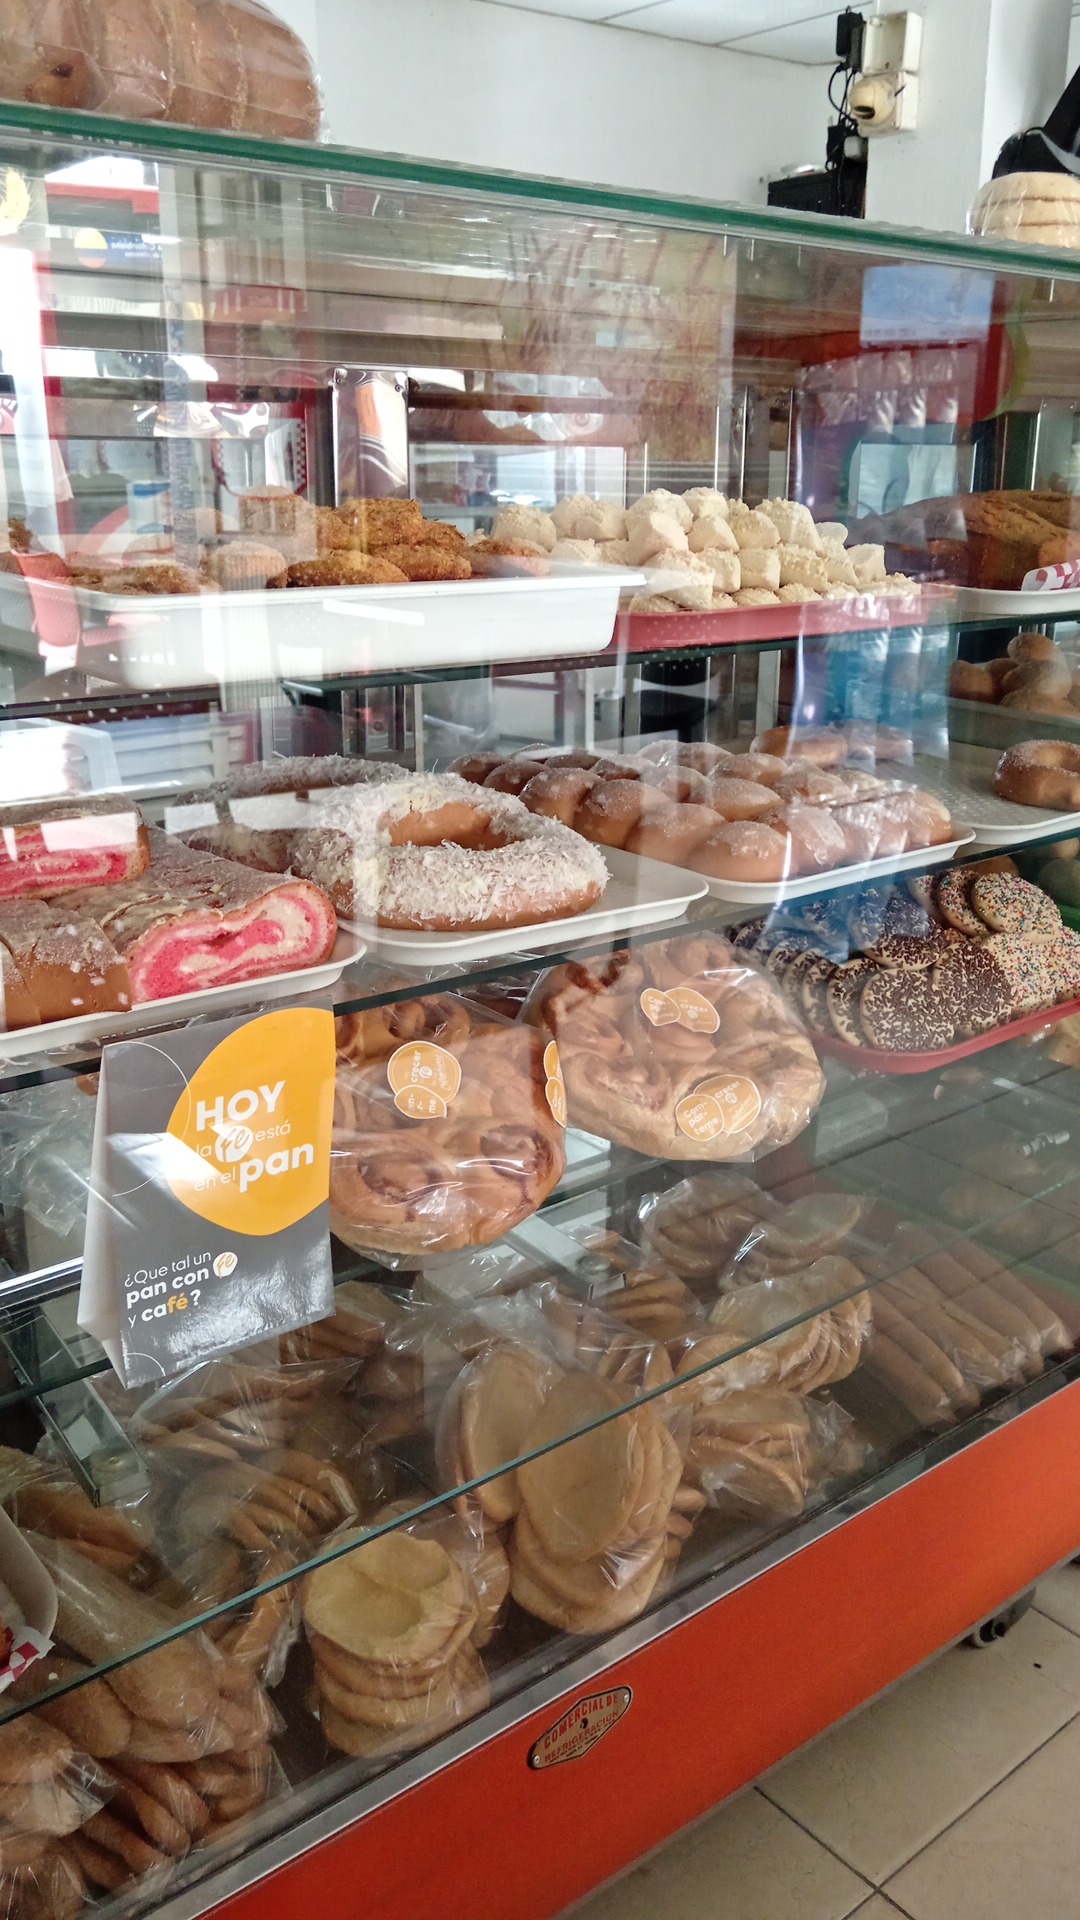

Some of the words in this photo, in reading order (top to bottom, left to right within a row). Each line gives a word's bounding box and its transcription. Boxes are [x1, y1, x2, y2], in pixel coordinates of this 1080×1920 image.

[411, 1049, 421, 1083] crecer
[196, 1080, 287, 1132] HOY
[714, 1080, 741, 1099] crecer
[683, 1101, 708, 1118] Com-
[688, 1111, 708, 1129] par-
[693, 1117, 719, 1136] teme
[196, 1143, 212, 1158] la
[255, 1119, 291, 1142] está
[194, 1175, 216, 1192] en
[220, 1166, 236, 1184] el
[239, 1143, 314, 1193] pan
[124, 1265, 168, 1288] ¿Que
[171, 1254, 190, 1273] tal
[193, 1251, 212, 1266] un
[126, 1281, 167, 1309] pan
[171, 1267, 209, 1289] con
[127, 1314, 137, 1329] y
[544, 1698, 604, 1750] COMERCIAL
[606, 1693, 619, 1707] DE
